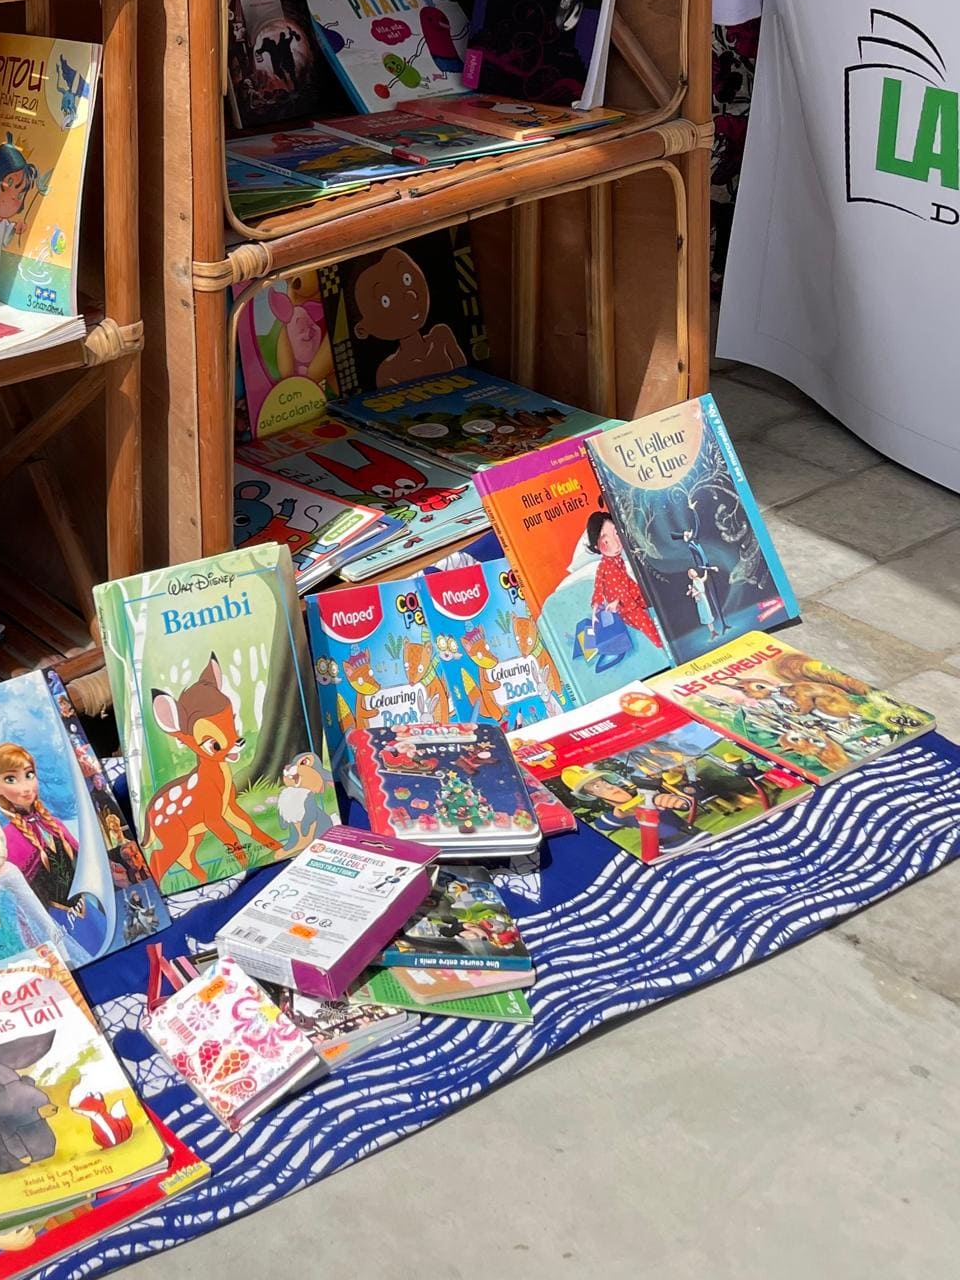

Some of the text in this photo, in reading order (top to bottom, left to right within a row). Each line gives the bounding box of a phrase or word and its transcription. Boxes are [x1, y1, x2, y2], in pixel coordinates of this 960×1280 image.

[277, 391, 303, 407] Com
[258, 397, 327, 431] autocolantes
[615, 428, 686, 469] Le Veilleur
[637, 451, 689, 483] de Lune
[521, 491, 543, 510] Aller
[544, 487, 553, 502] à
[523, 505, 562, 532] pour quoi
[442, 584, 480, 606] Maped
[160, 591, 253, 636] Bambi
[331, 606, 373, 628] Maped
[490, 662, 531, 682] Colouring
[673, 644, 785, 698] LES ECUREUILS
[368, 690, 417, 711] Colouring
[502, 678, 536, 700] Book
[426, 743, 461, 755] Noël
[9, 995, 63, 1028] Tail
